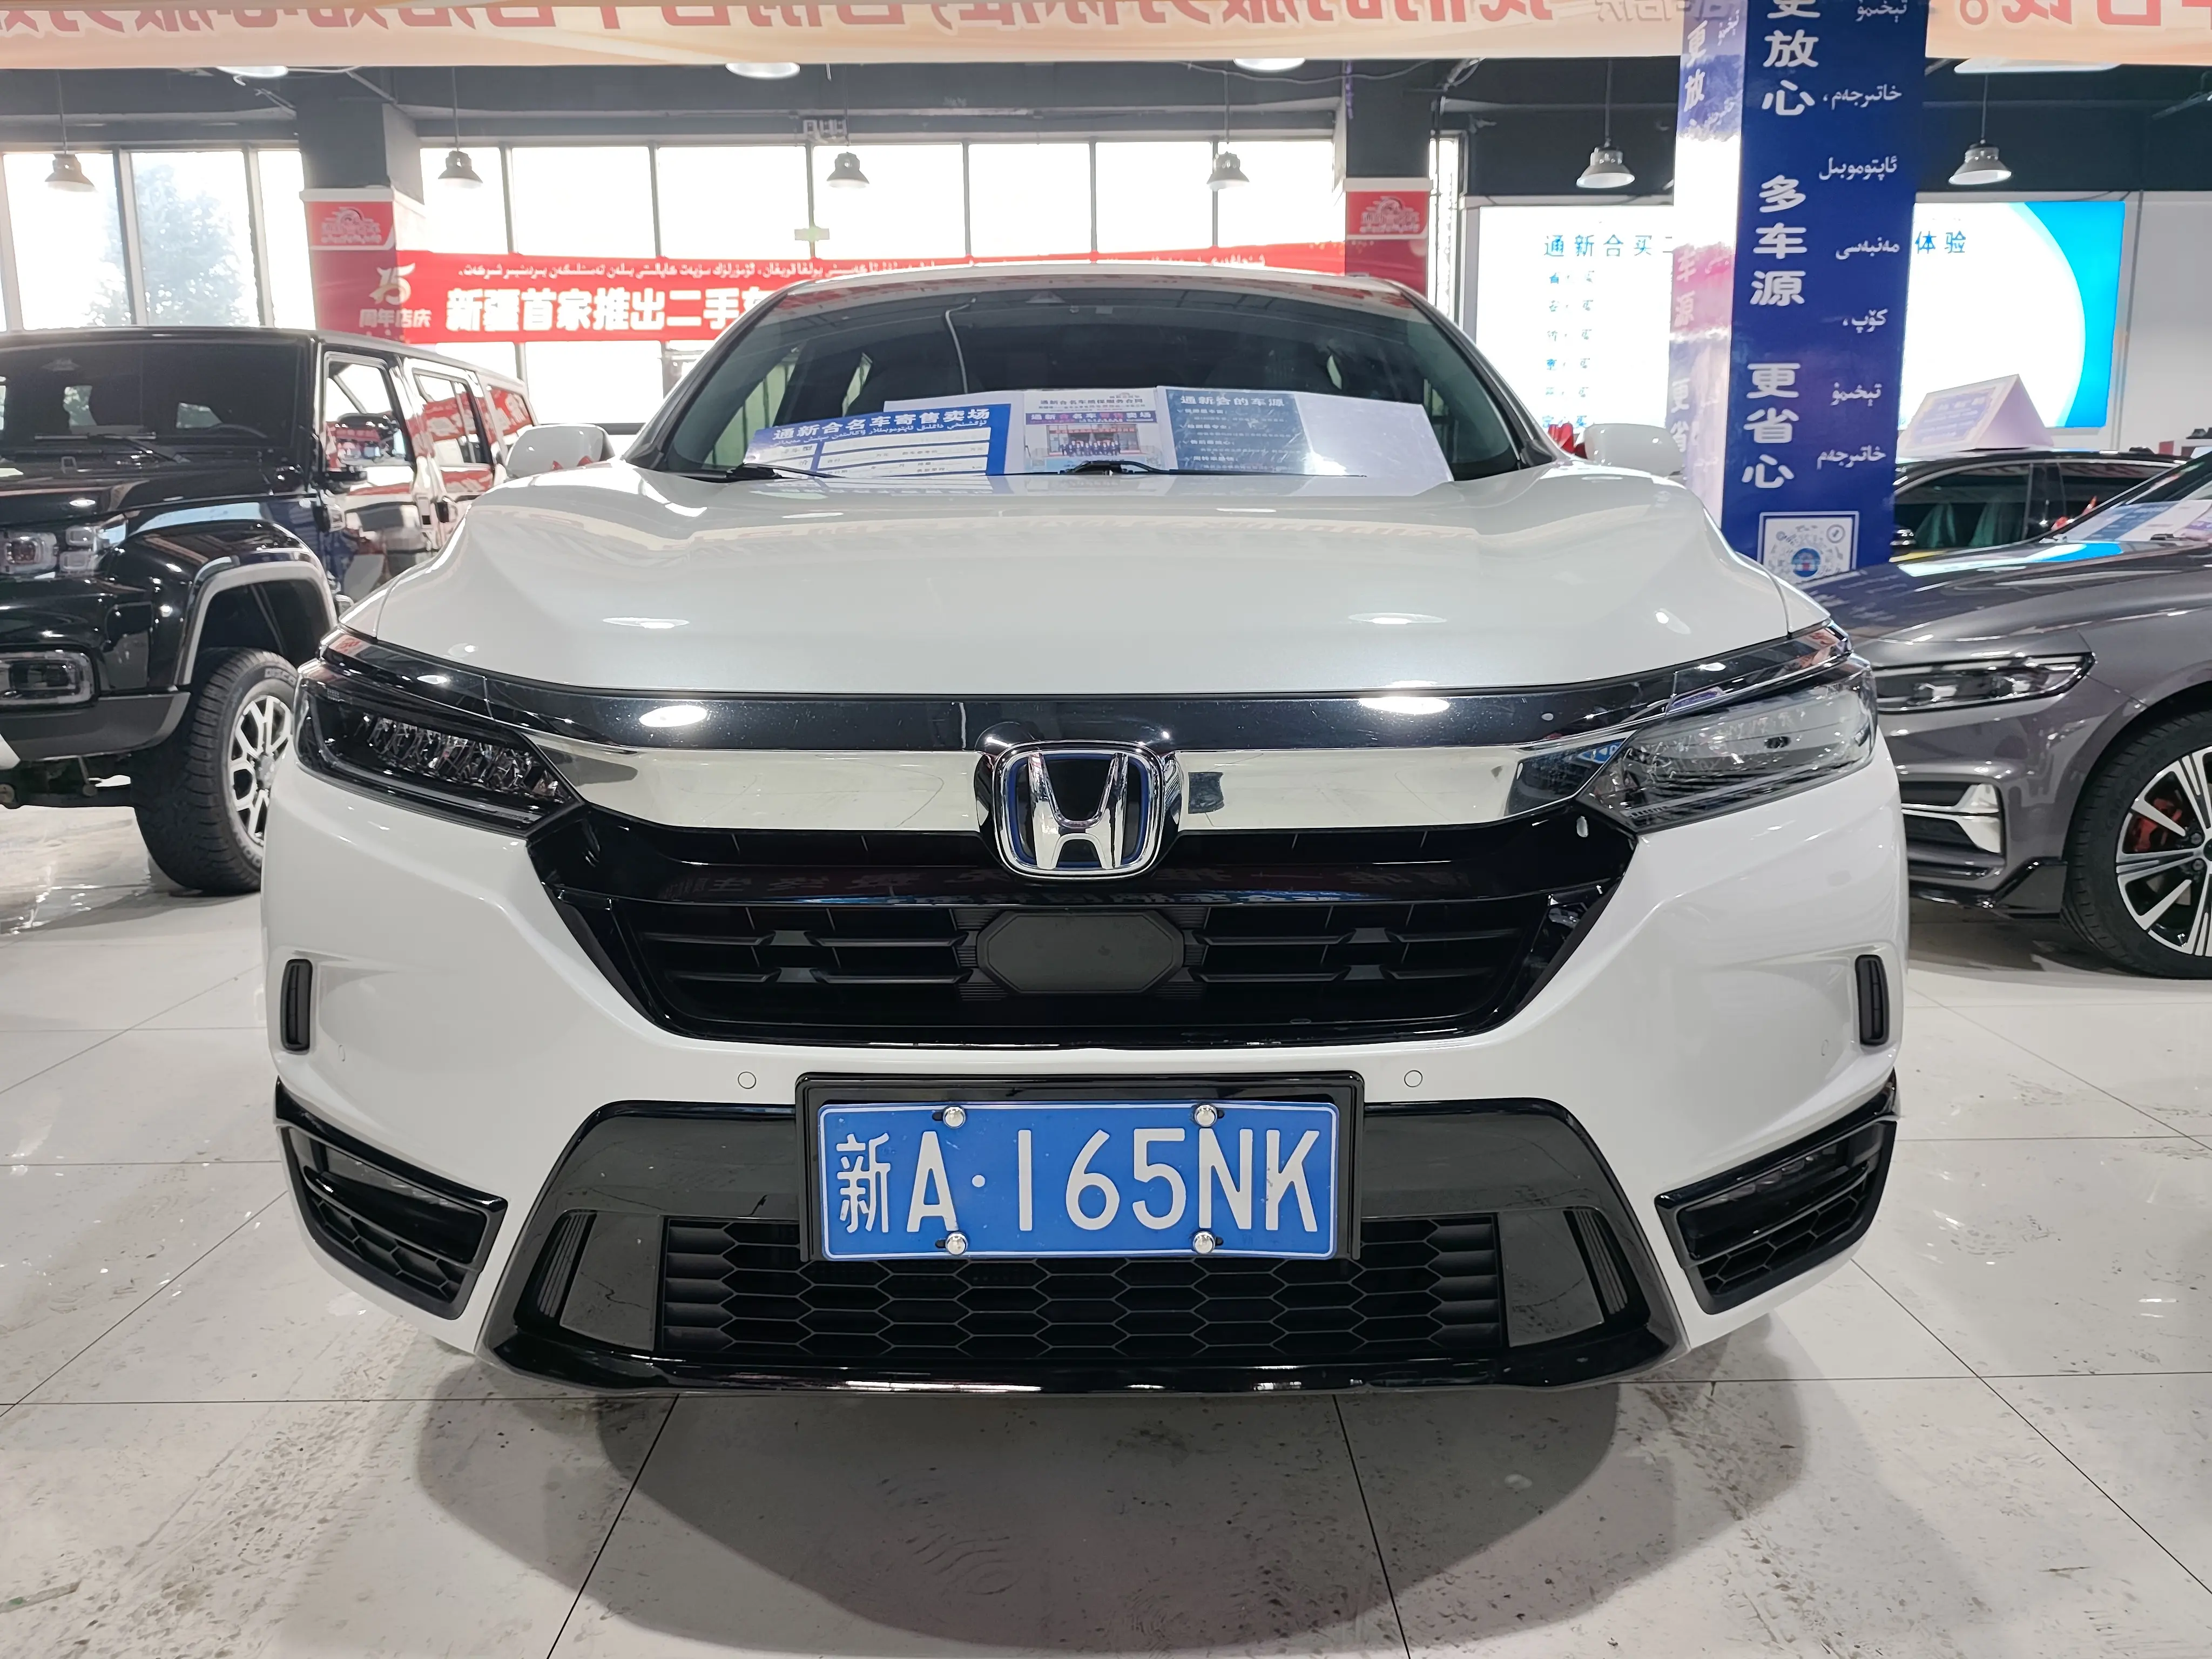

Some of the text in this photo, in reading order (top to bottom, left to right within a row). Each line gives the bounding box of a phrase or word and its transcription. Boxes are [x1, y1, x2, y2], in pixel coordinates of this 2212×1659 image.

[1750, 175, 1808, 306] 多车源
[1915, 231, 1966, 254] 体验
[359, 308, 432, 328] 周年店庆
[772, 408, 990, 440] 通新合名车寄售卖场
[1742, 363, 1801, 489] 更省心
[836, 1128, 1320, 1233] 新A·165NK
